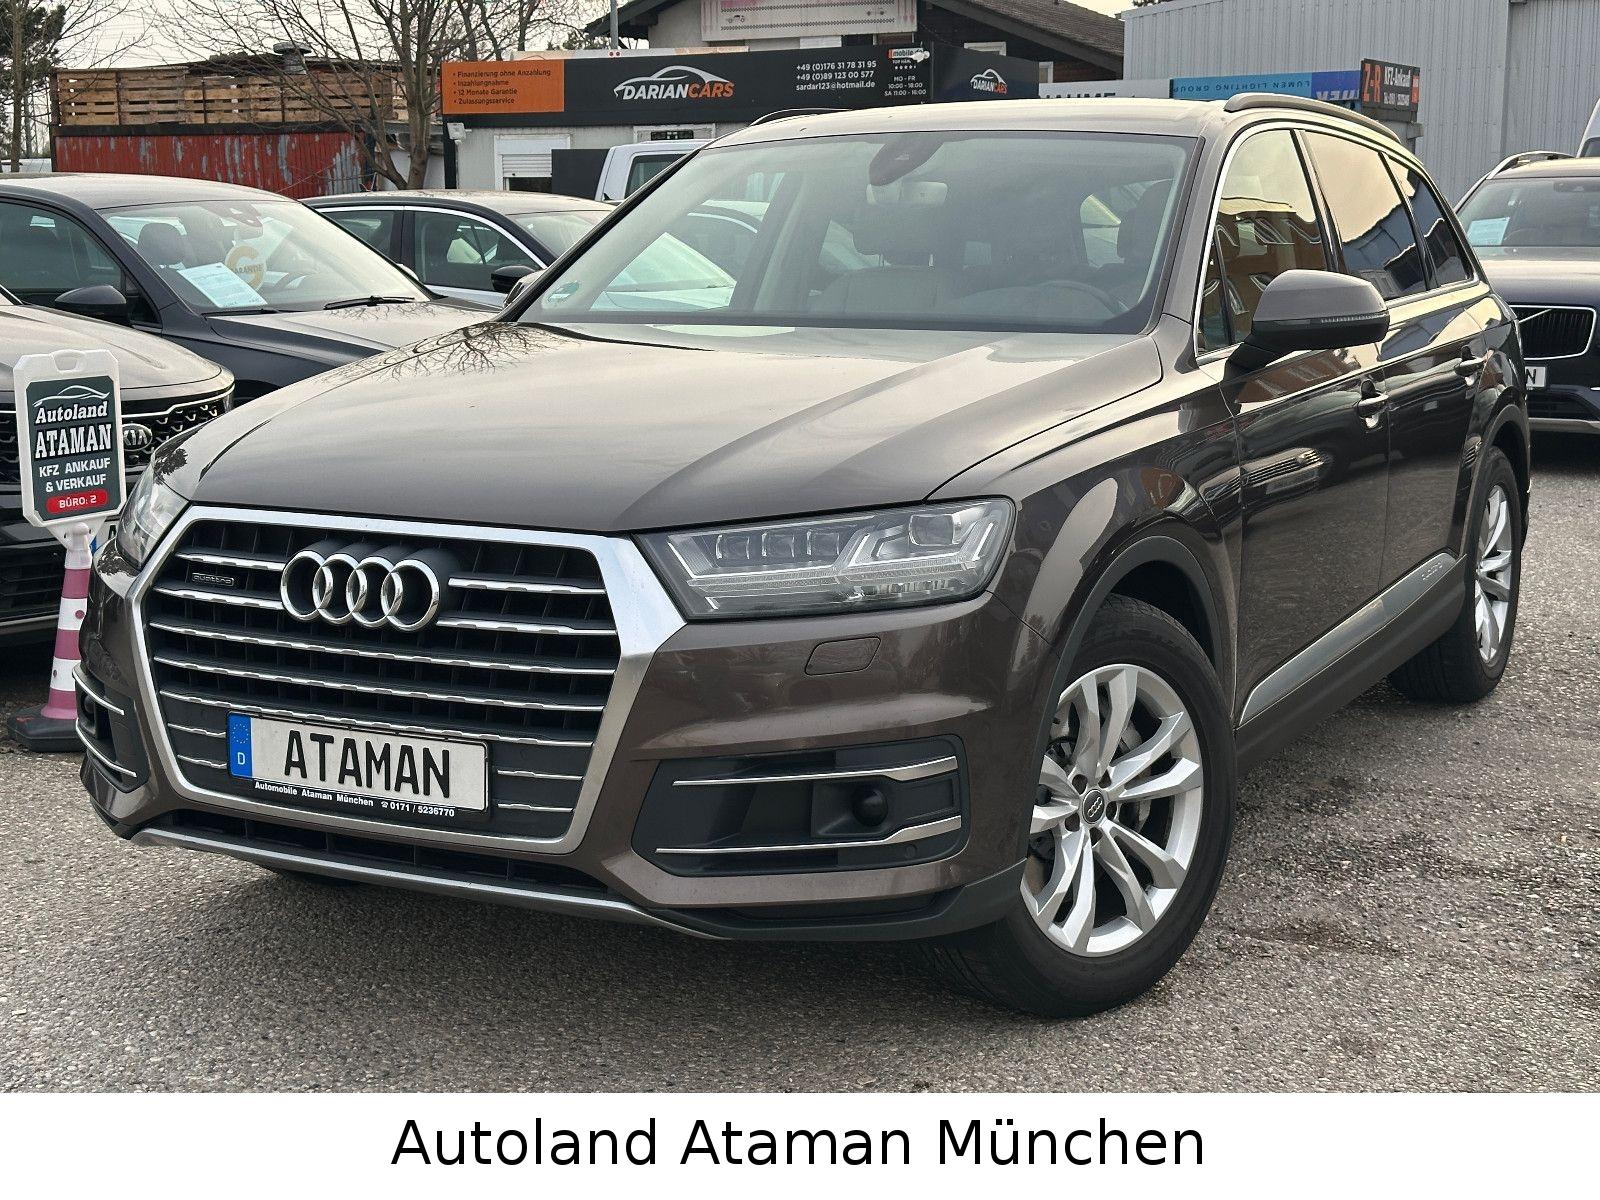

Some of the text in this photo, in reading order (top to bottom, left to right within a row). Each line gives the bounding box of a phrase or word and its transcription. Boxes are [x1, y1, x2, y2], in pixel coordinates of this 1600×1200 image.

[796, 63, 810, 71] +49
[812, 62, 836, 71] (0)176
[847, 61, 856, 69] 78
[867, 60, 877, 68] 95
[517, 69, 551, 77] Anzahlung
[796, 73, 810, 81] +49
[812, 72, 832, 81] (0)89
[849, 71, 859, 79] 00
[796, 81, 876, 91] sardar123@hotmail.de
[1216, 82, 1267, 90] LIGHTING
[1273, 80, 1310, 88] LUMEN
[35, 401, 108, 424] Autoland
[35, 424, 112, 459] ATAMAN
[39, 457, 111, 478] KFZ ANKAUF
[45, 474, 107, 492] & VERKAUF
[58, 495, 97, 509] BÜRO: 2
[237, 752, 246, 765] D
[284, 729, 450, 799] ATAMAN
[255, 782, 298, 796] Automobile
[301, 788, 333, 801] Ataman
[336, 793, 374, 807] München
[390, 802, 410, 812] 0171
[418, 806, 455, 817] 5236770
